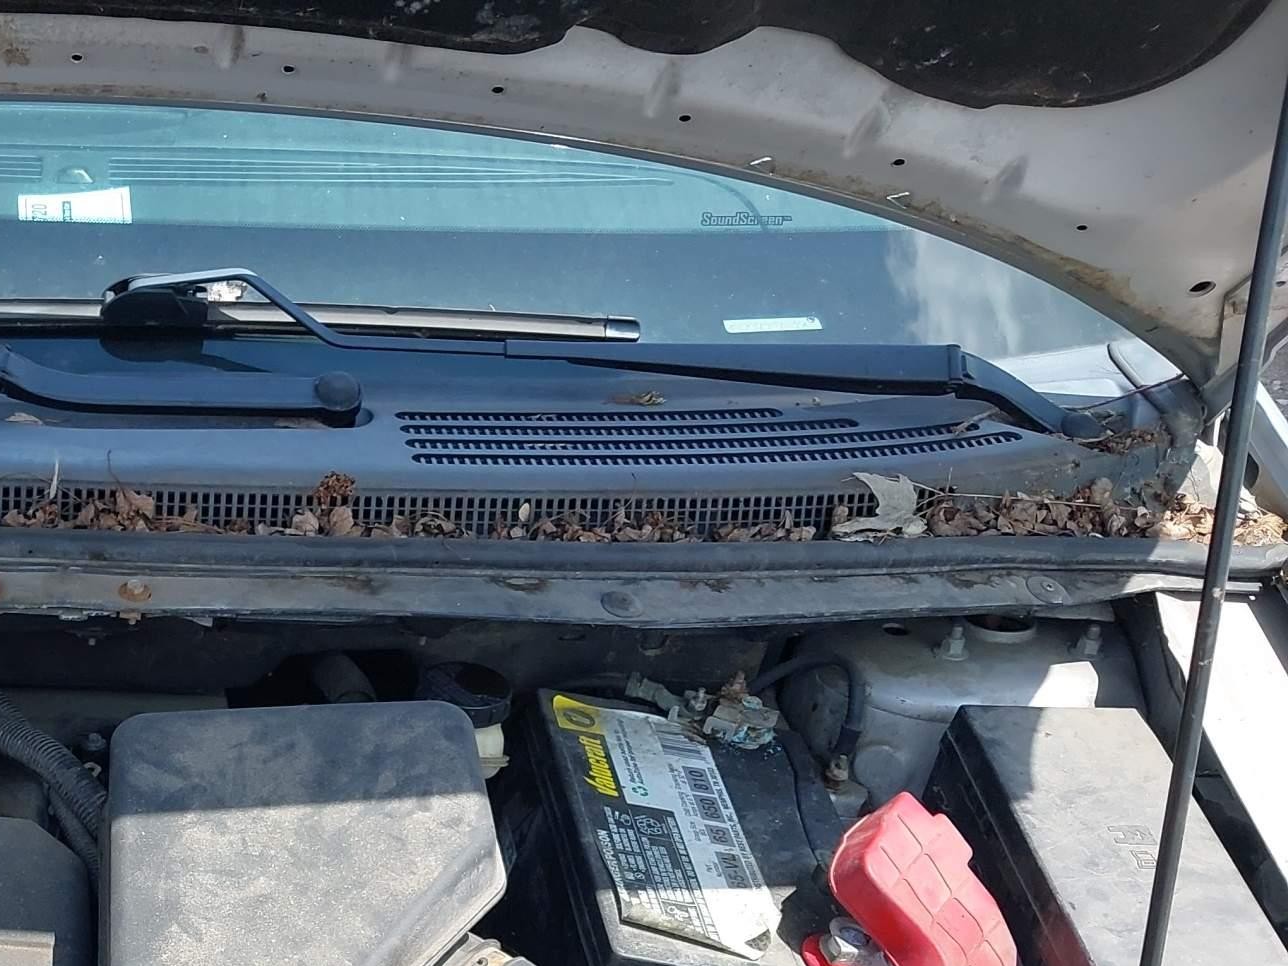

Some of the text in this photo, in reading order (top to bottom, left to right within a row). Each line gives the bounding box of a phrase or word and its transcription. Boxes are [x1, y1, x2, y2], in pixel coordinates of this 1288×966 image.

[578, 735, 620, 798] Valucraft
[688, 770, 709, 791] 810
[700, 798, 721, 819] 650
[710, 828, 728, 843] 65
